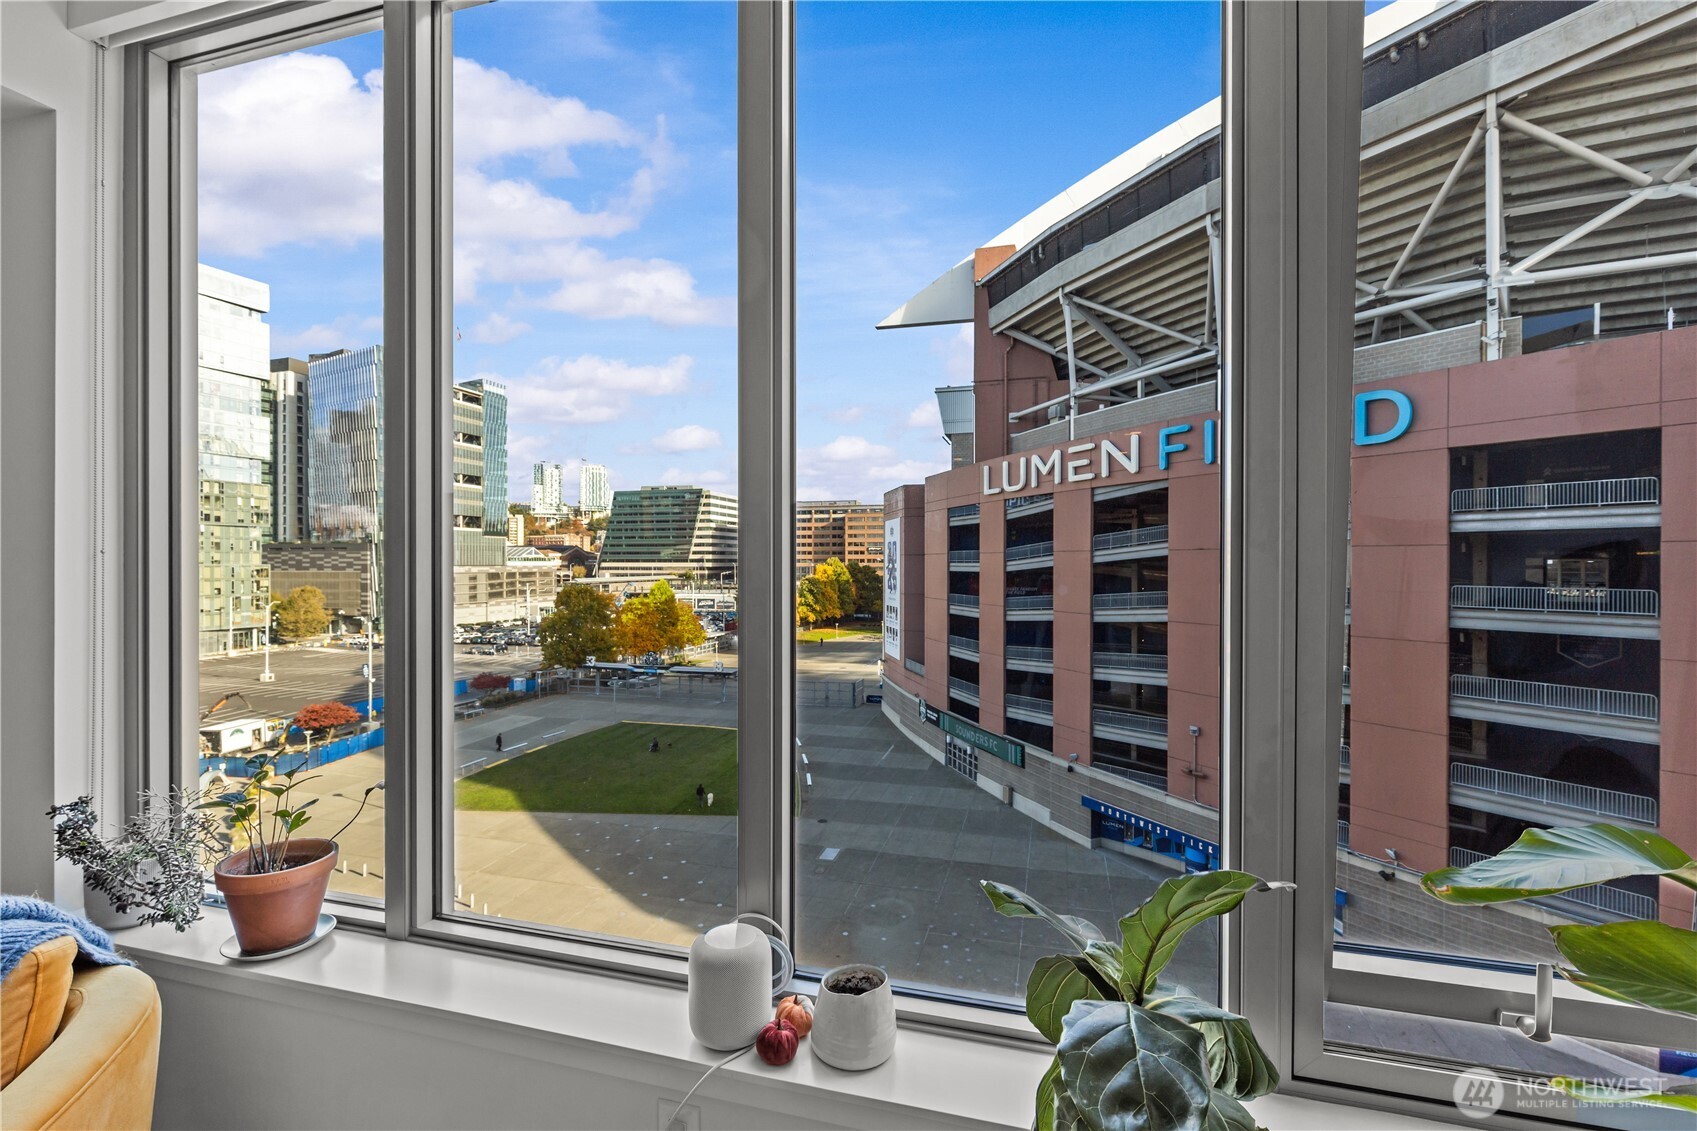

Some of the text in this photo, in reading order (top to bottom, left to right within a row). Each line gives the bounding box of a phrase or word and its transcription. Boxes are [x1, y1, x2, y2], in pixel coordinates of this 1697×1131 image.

[983, 434, 1140, 495] LUMEN
[955, 724, 998, 752] SOUNDERS FC
[1101, 805, 1214, 854] NORTHWEST TICK
